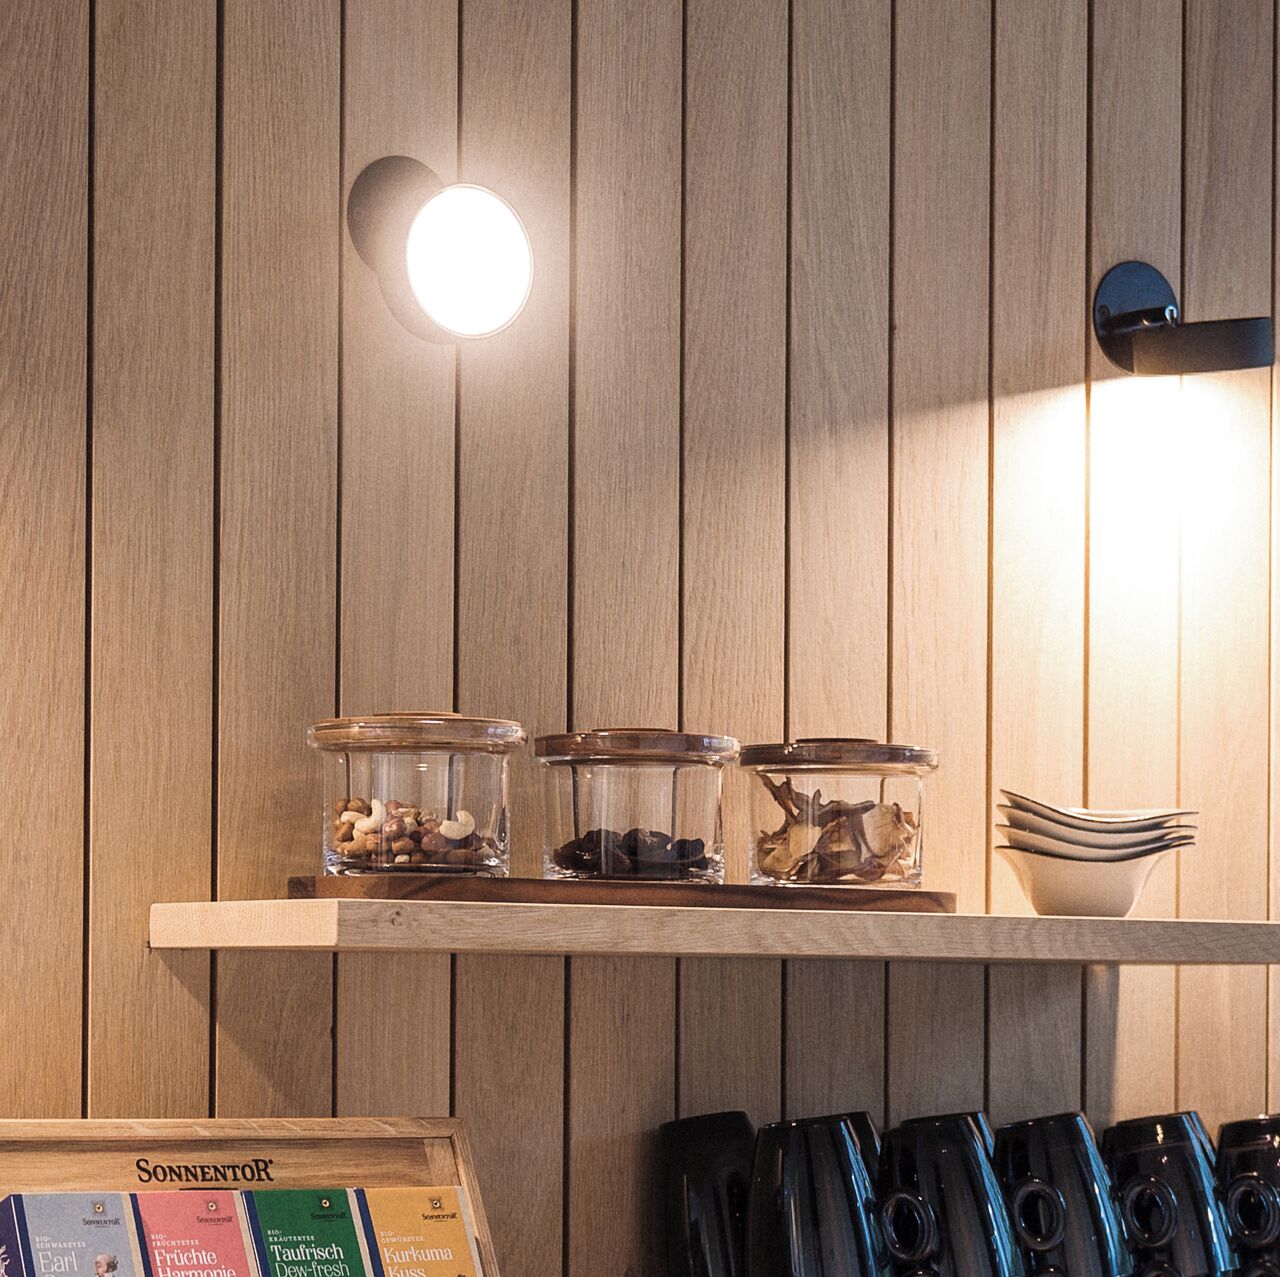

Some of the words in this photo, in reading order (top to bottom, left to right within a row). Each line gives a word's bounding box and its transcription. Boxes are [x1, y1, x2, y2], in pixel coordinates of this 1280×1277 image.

[154, 1248, 217, 1266] Früchte
[270, 1243, 344, 1261] Taufrisch
[384, 1246, 453, 1263] Kurkuma
[39, 1250, 78, 1273] Earl
